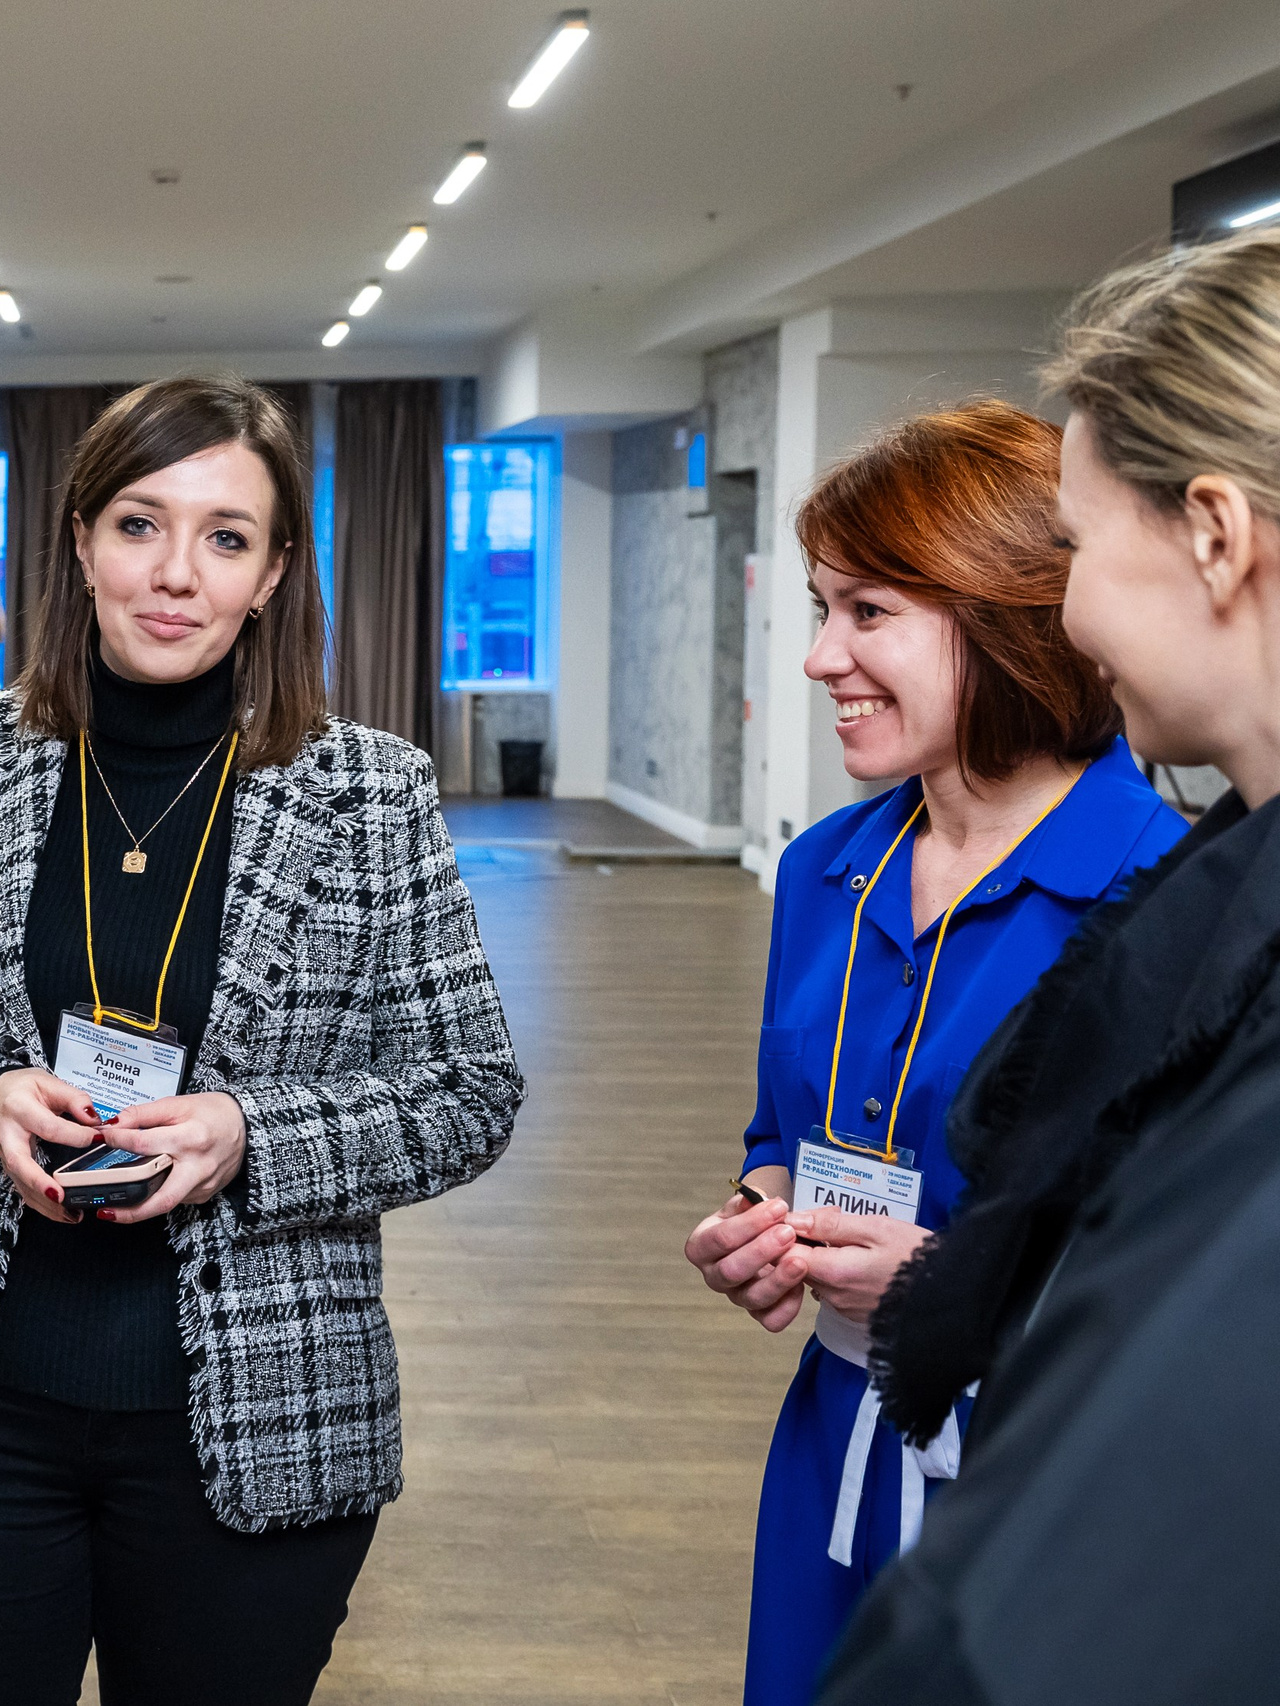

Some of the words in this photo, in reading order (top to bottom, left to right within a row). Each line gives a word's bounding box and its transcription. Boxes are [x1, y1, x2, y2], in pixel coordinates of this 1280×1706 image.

[66, 1029, 104, 1046] PR-РАБОТЫ
[68, 1024, 92, 1035] НОВЫЕ
[92, 1031, 138, 1050] ТЕХНОЛОГИИ
[94, 1052, 141, 1077] Алена
[72, 1070, 101, 1082] начальник
[102, 1079, 122, 1090] отдела
[130, 1088, 151, 1100] связям
[96, 1066, 134, 1086] Гарина
[87, 1081, 138, 1102] общественностью
[808, 1150, 844, 1164] КОНФЕРЕНЦИЯ
[802, 1164, 839, 1180] PR-РАБОТЫ
[844, 1175, 862, 1185] 2023
[803, 1156, 826, 1167] НОВЫЕ
[827, 1162, 873, 1180] ТЕХНОЛОГИИ
[894, 1173, 914, 1182] НОЯБРЯ
[888, 1188, 908, 1198] Москва
